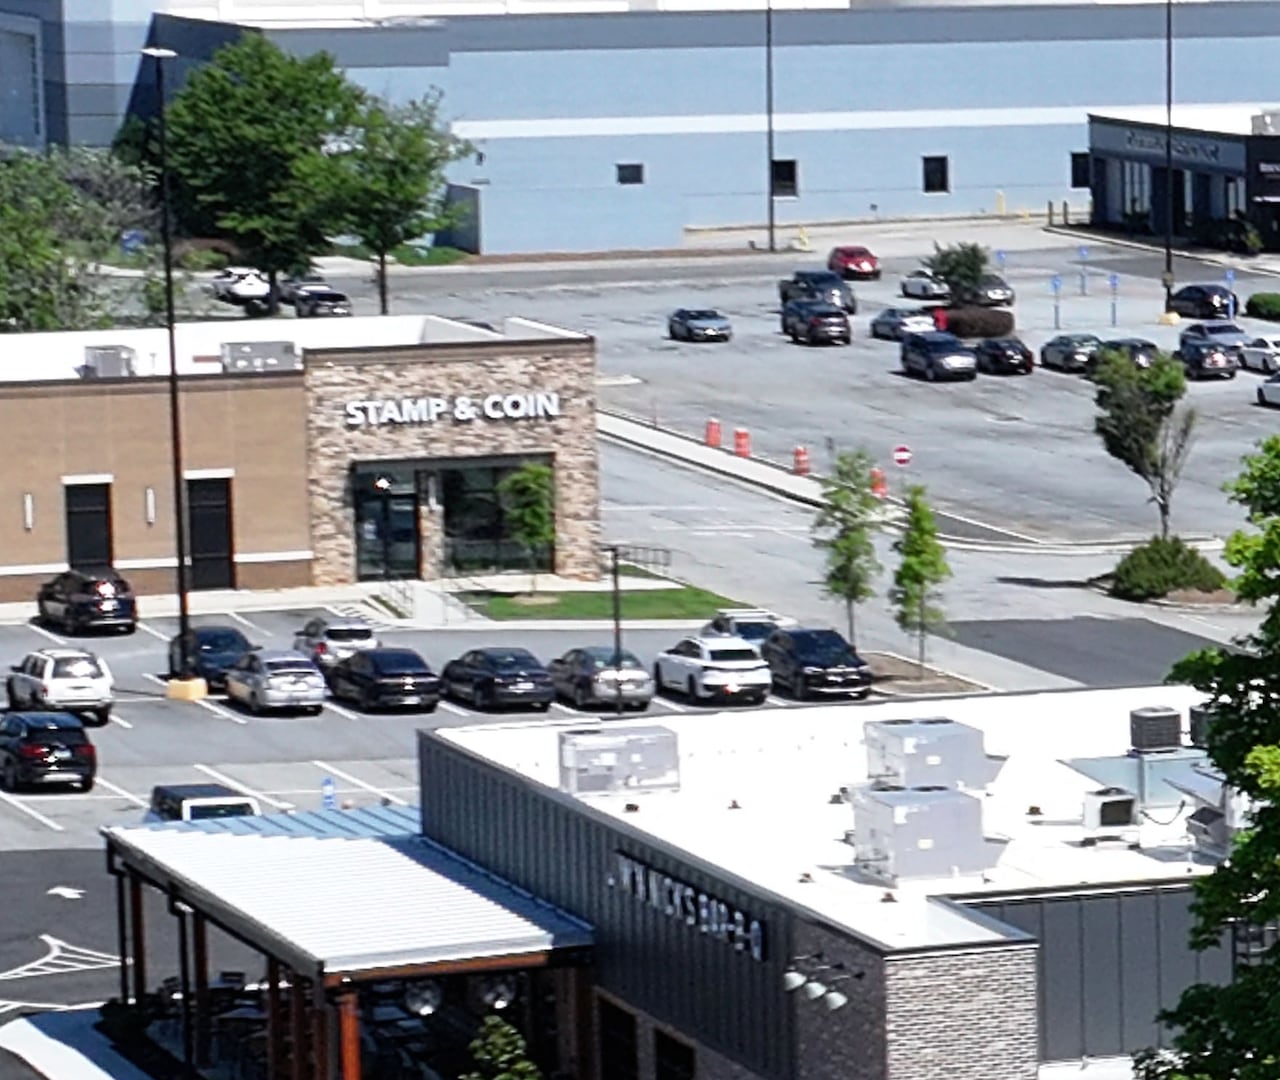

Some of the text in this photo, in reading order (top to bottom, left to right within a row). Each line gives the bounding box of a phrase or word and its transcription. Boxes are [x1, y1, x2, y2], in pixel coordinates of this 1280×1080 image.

[346, 393, 560, 425] STAMP & COIN
